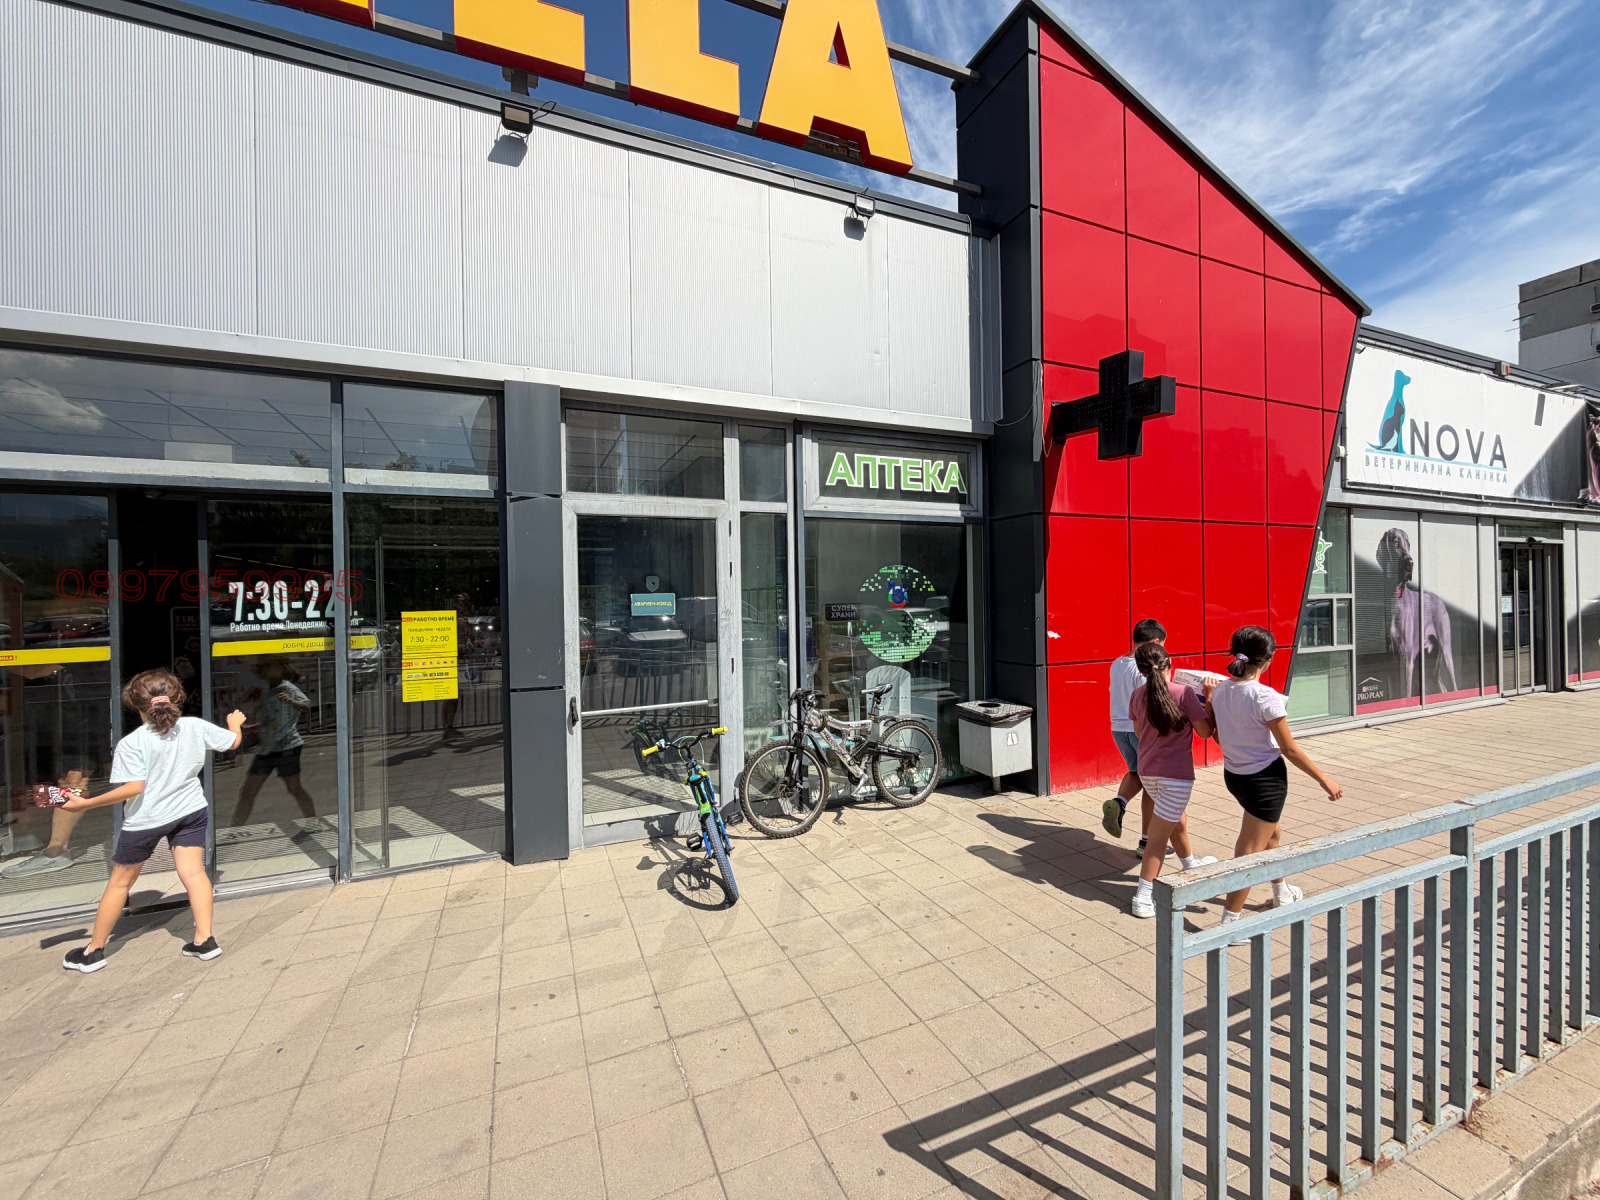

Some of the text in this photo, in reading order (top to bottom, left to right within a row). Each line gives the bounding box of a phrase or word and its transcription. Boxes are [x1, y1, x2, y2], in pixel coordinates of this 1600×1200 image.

[1410, 418, 1507, 468] NOVA
[1365, 455, 1451, 477] ВЕТЕРИНАРНА
[825, 452, 968, 494] АПТЕКА
[831, 604, 856, 612] СУПЕР
[831, 611, 856, 619] ХРАНИ
[230, 622, 260, 632] Работно
[285, 620, 327, 630] Понеделник
[1357, 690, 1384, 701] PRO PLAN
